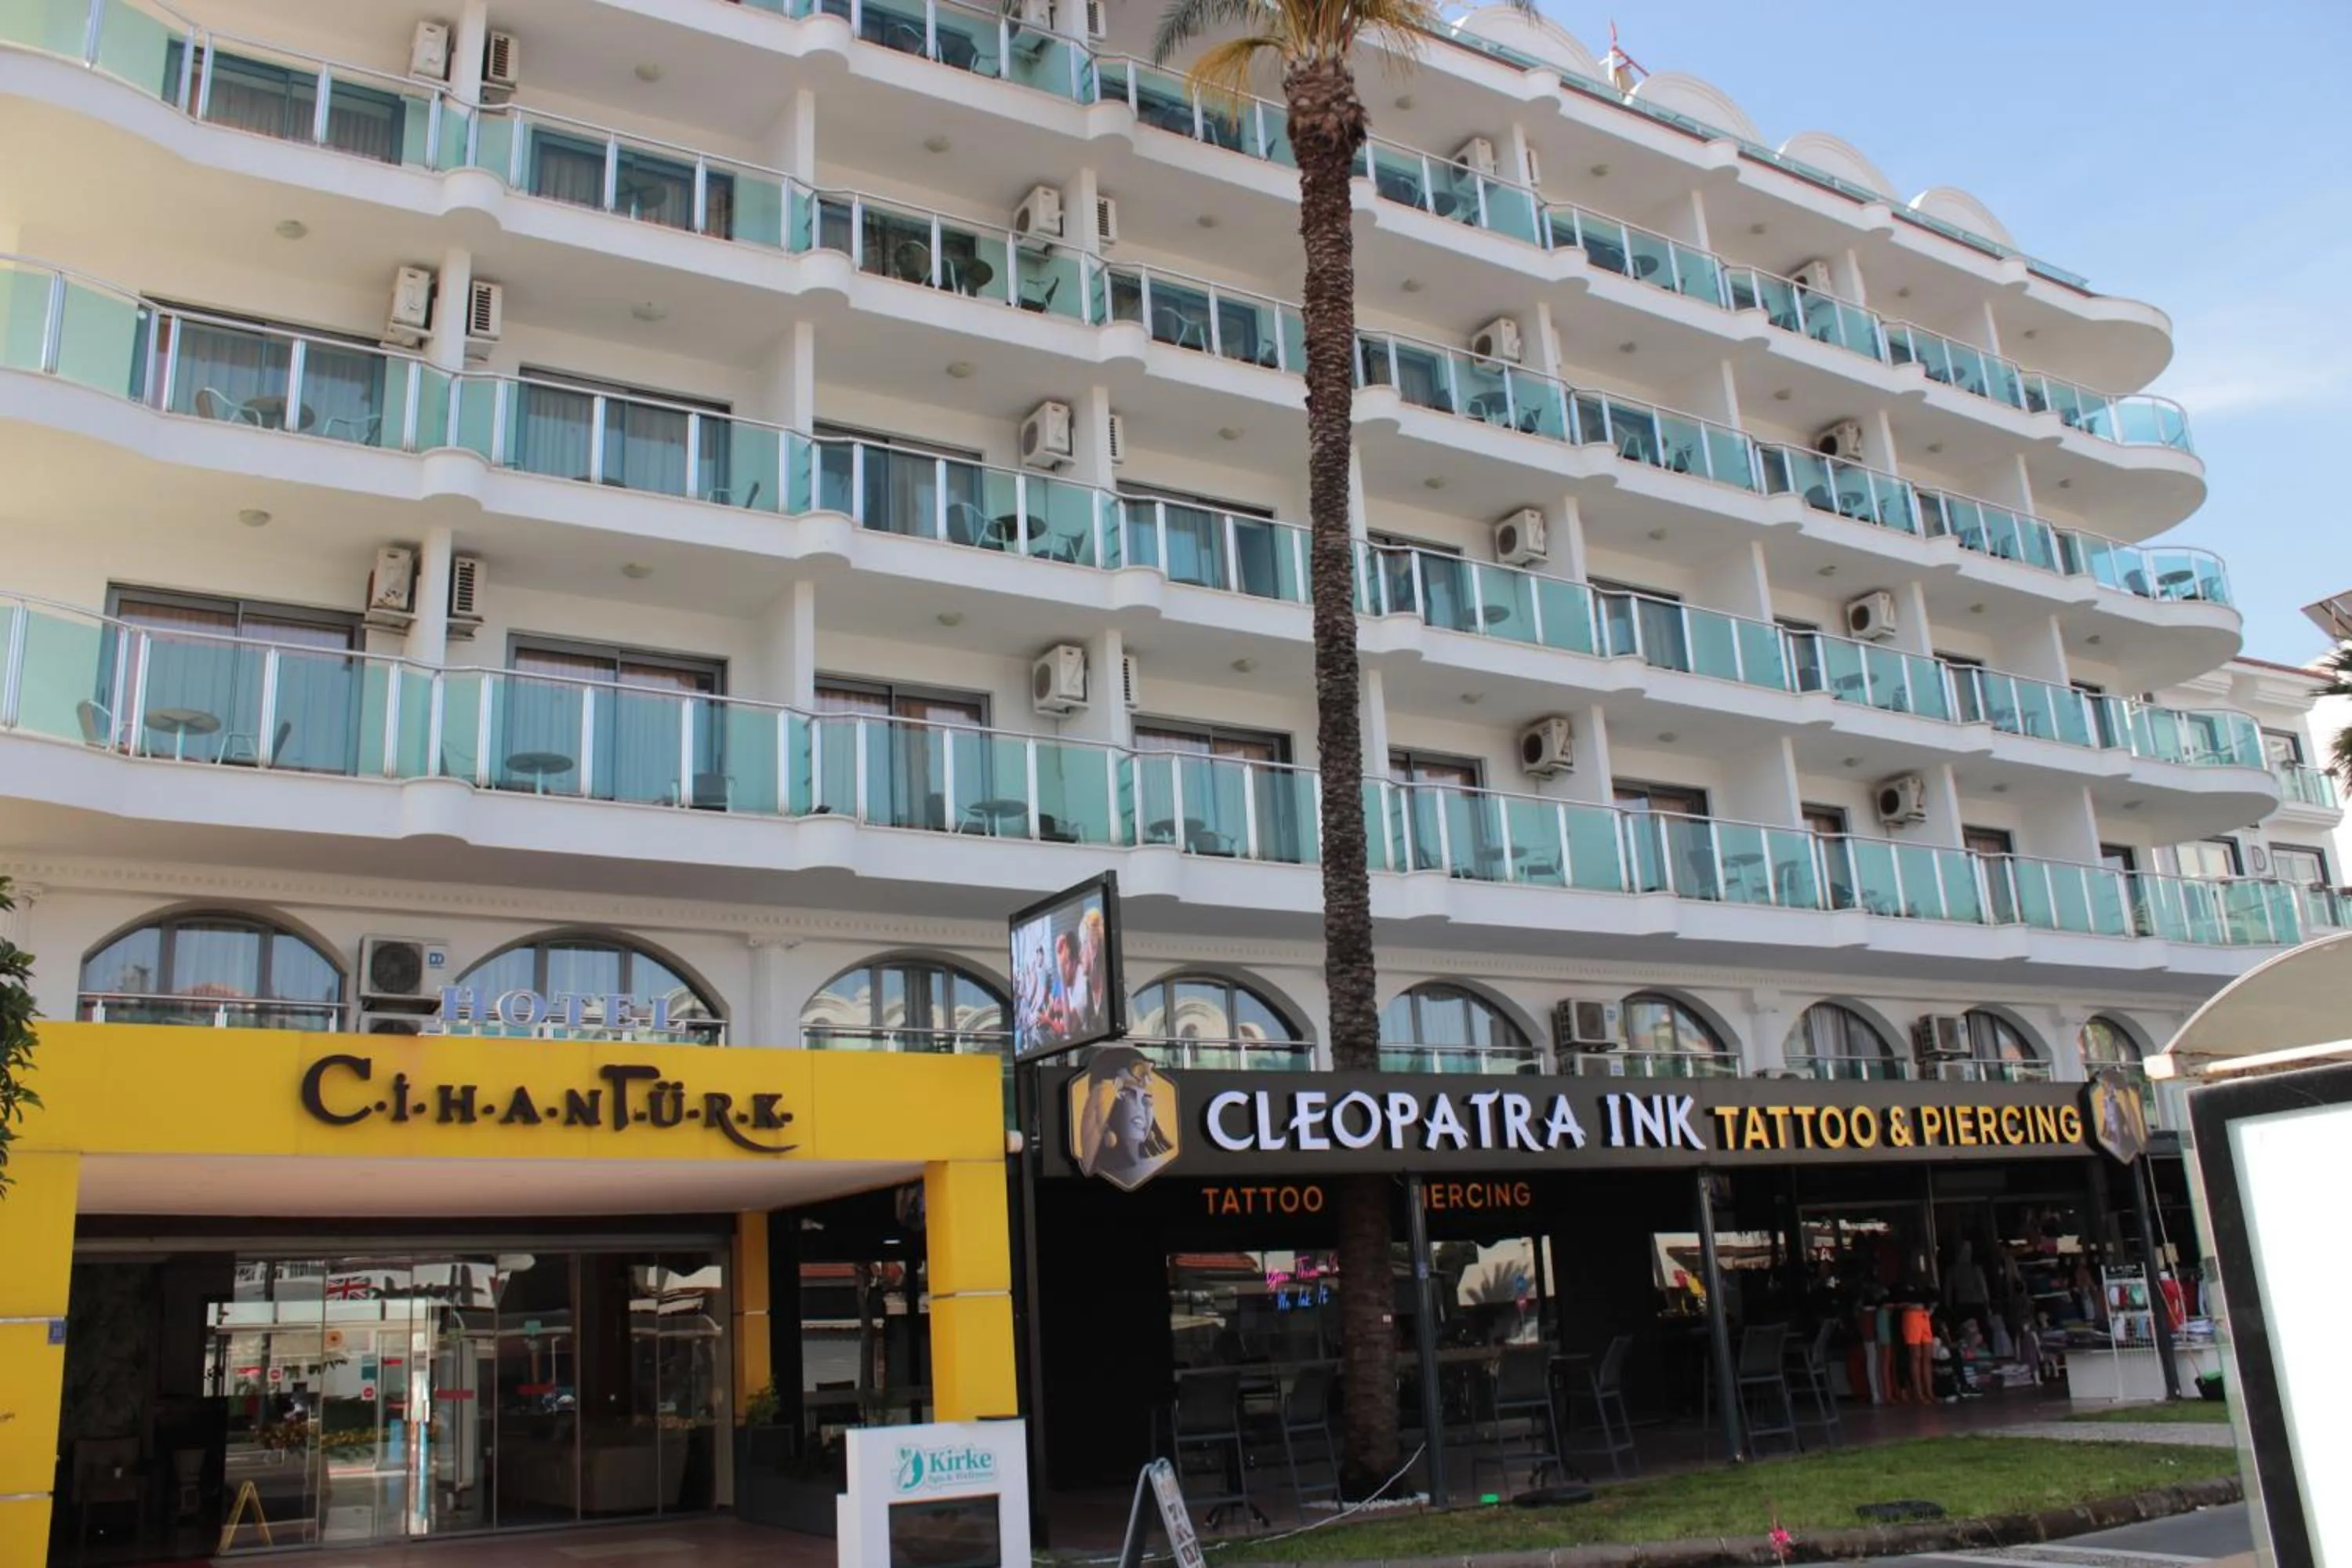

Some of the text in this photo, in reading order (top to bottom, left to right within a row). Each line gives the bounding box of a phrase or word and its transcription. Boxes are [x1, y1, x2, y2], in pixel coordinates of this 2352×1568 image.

[438, 985, 688, 1034] HOTEL
[1207, 1088, 2083, 1152] CLEOPATRA INK TATTOO & PIERCING
[1203, 1182, 1530, 1214] TATTOO IERCING
[929, 1449, 992, 1472] Kirke
